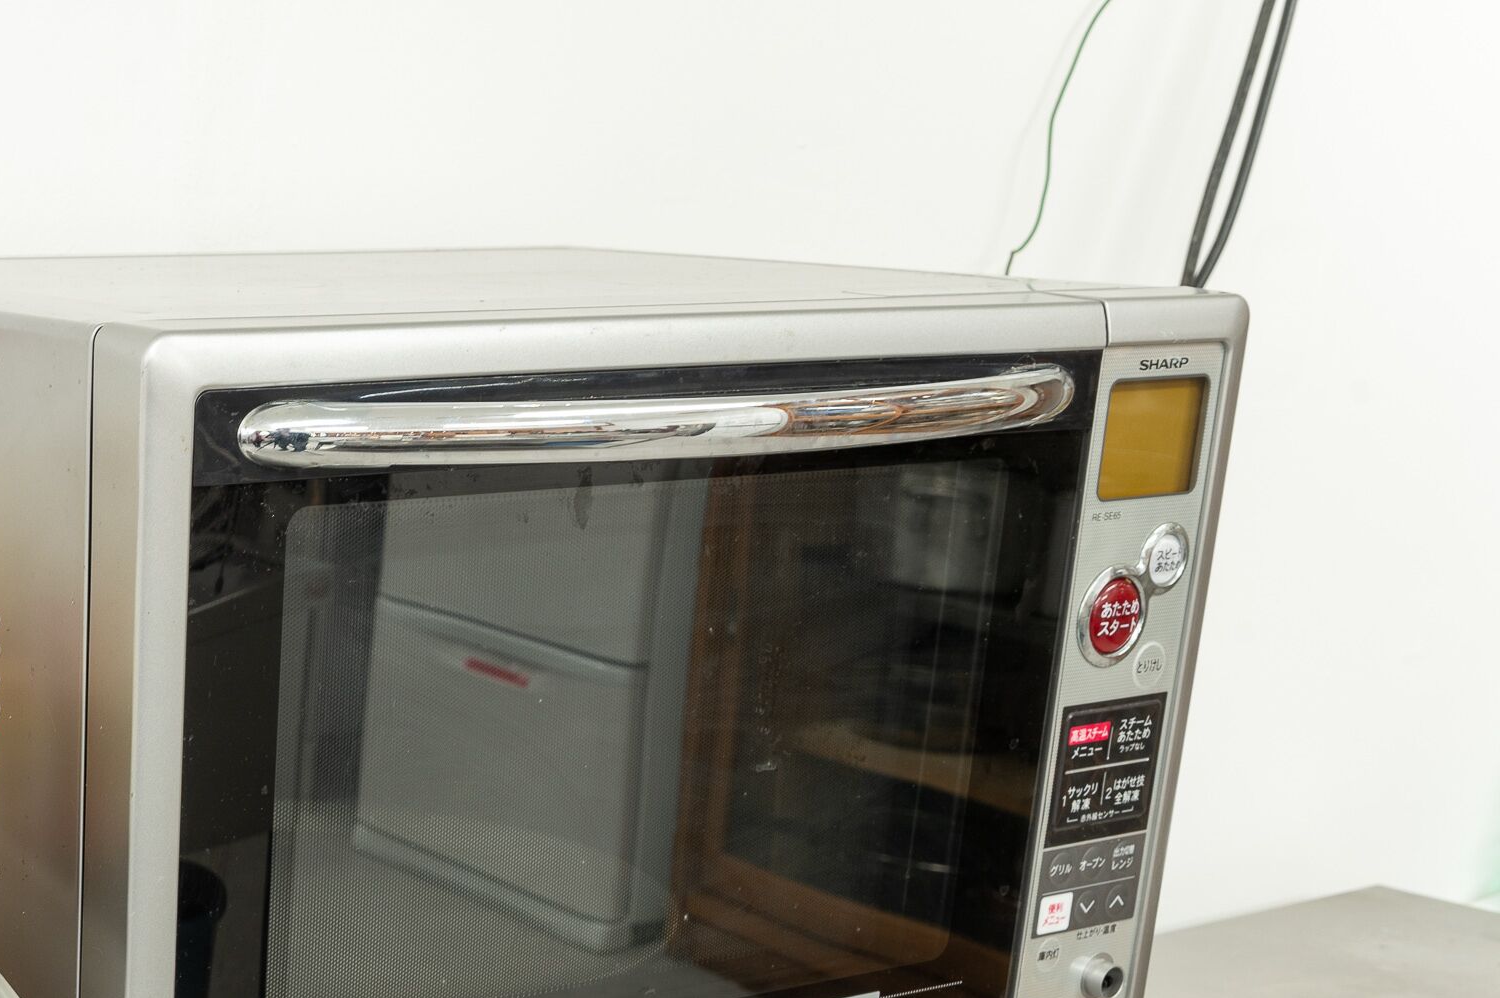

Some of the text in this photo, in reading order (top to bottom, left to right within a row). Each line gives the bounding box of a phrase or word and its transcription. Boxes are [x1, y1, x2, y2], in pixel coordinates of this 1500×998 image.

[1139, 357, 1189, 371] SHARP
[1100, 598, 1140, 619] あたため
[1097, 616, 1137, 637] スタート
[1137, 658, 1163, 674] とりけし
[1120, 715, 1153, 730] スチーム
[1071, 727, 1109, 742] 高温スチーム
[1117, 728, 1152, 743] あたため
[1071, 746, 1103, 759] メニュー
[1119, 743, 1145, 753] ラップなし
[1062, 782, 1098, 807] 1 サックリ
[1105, 787, 1113, 799] 2
[1114, 789, 1140, 805] 全解凍
[1070, 798, 1091, 813] 解凍
[1050, 857, 1134, 877] グリル オープン レンジ
[1048, 902, 1064, 914] 便利
[1043, 915, 1067, 927] メニュー
[1037, 948, 1059, 961] 庫内灯
